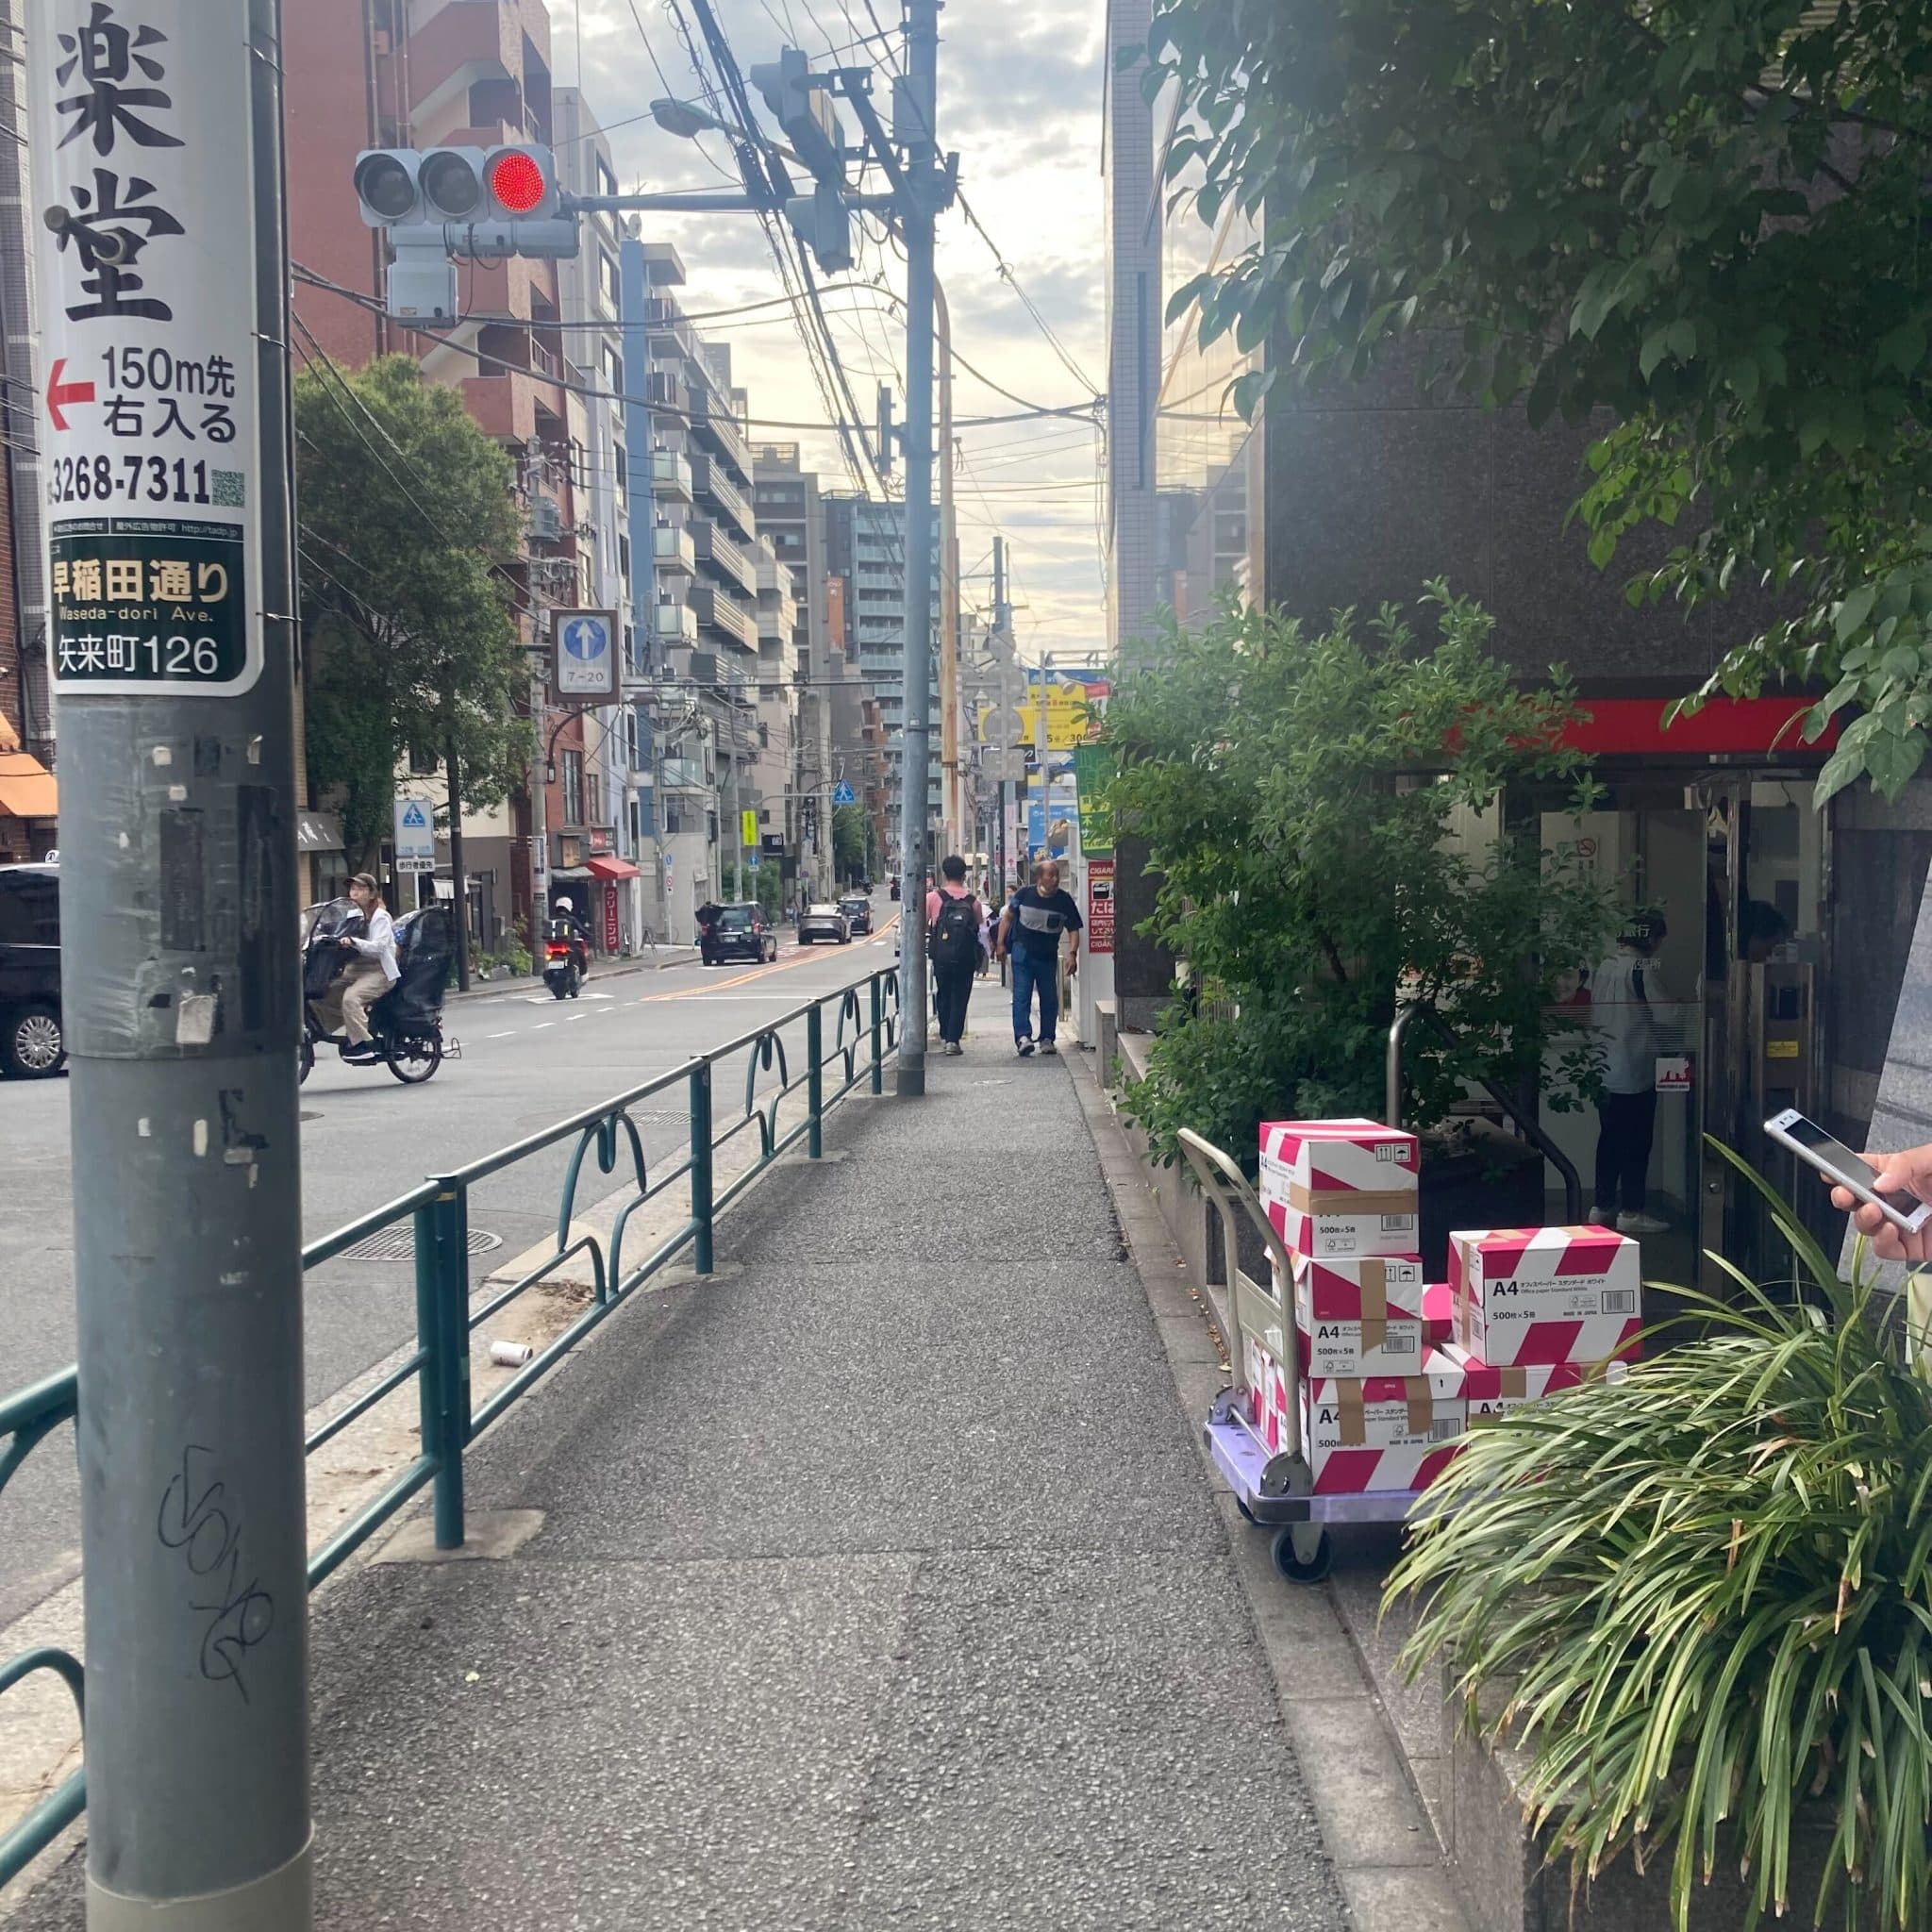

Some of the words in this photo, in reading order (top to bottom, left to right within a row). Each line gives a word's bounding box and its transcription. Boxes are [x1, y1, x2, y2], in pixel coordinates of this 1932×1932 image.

[101, 345, 235, 398] 150m先
[103, 394, 236, 443] 右入る
[53, 454, 210, 505] 3268-7311
[53, 558, 228, 604] 早稲田通り
[58, 606, 158, 622] Waseda-dori
[171, 606, 214, 623] Ave.
[58, 633, 219, 675] 矢来町126
[1492, 1280, 1519, 1297] A4
[1318, 1325, 1340, 1339] A4
